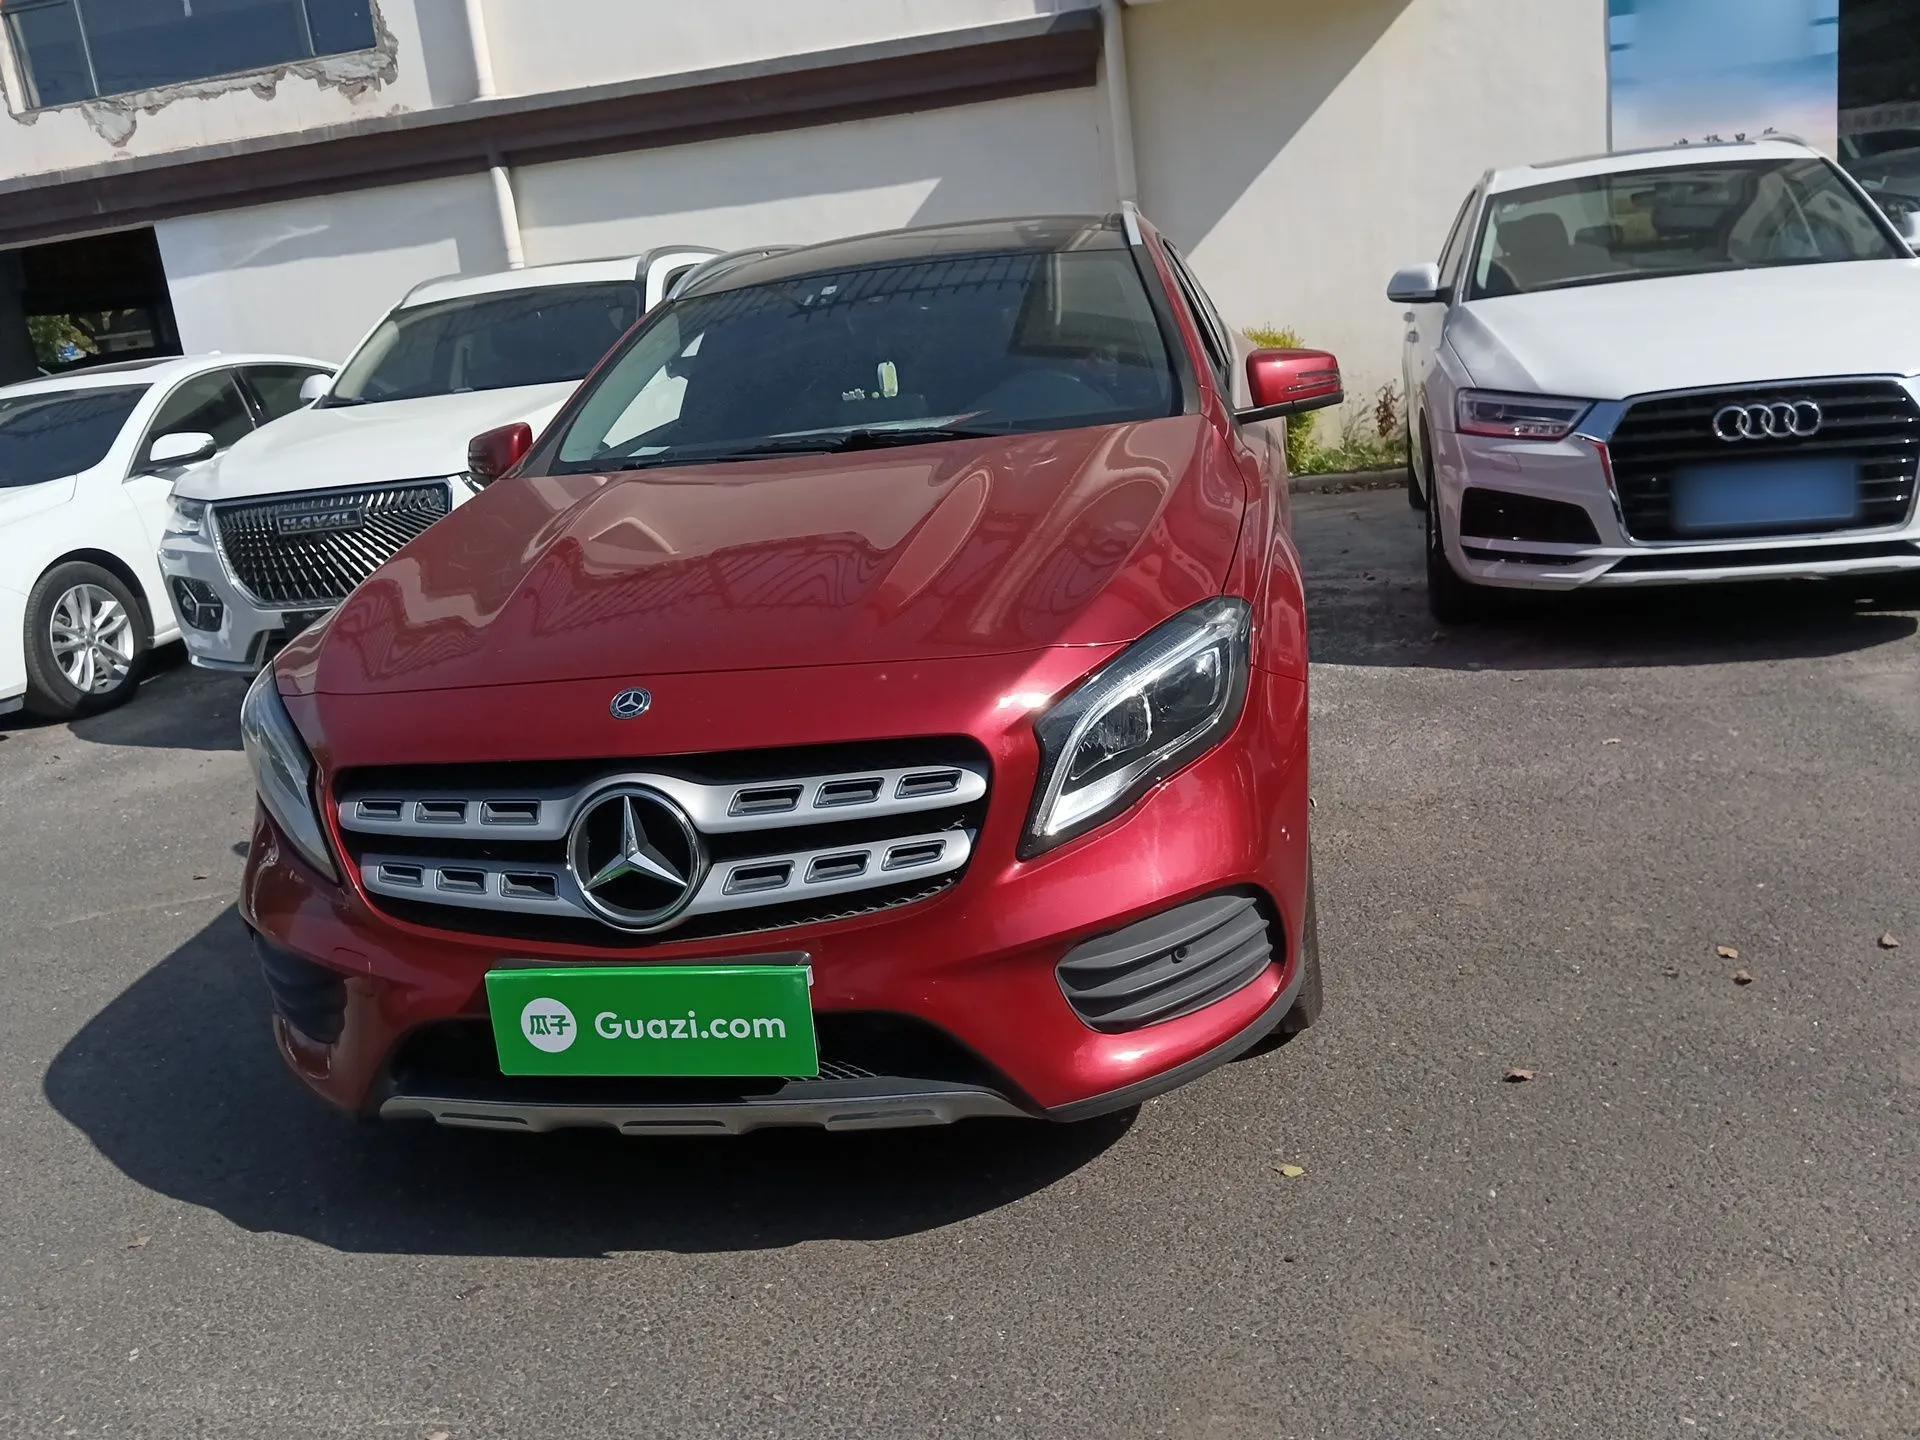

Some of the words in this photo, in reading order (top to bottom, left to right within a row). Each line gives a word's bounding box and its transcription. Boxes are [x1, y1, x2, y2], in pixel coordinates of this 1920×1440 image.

[283, 514, 355, 530] HAVAL
[529, 1015, 570, 1035] 瓜子
[594, 1011, 786, 1039] Guazi.com
